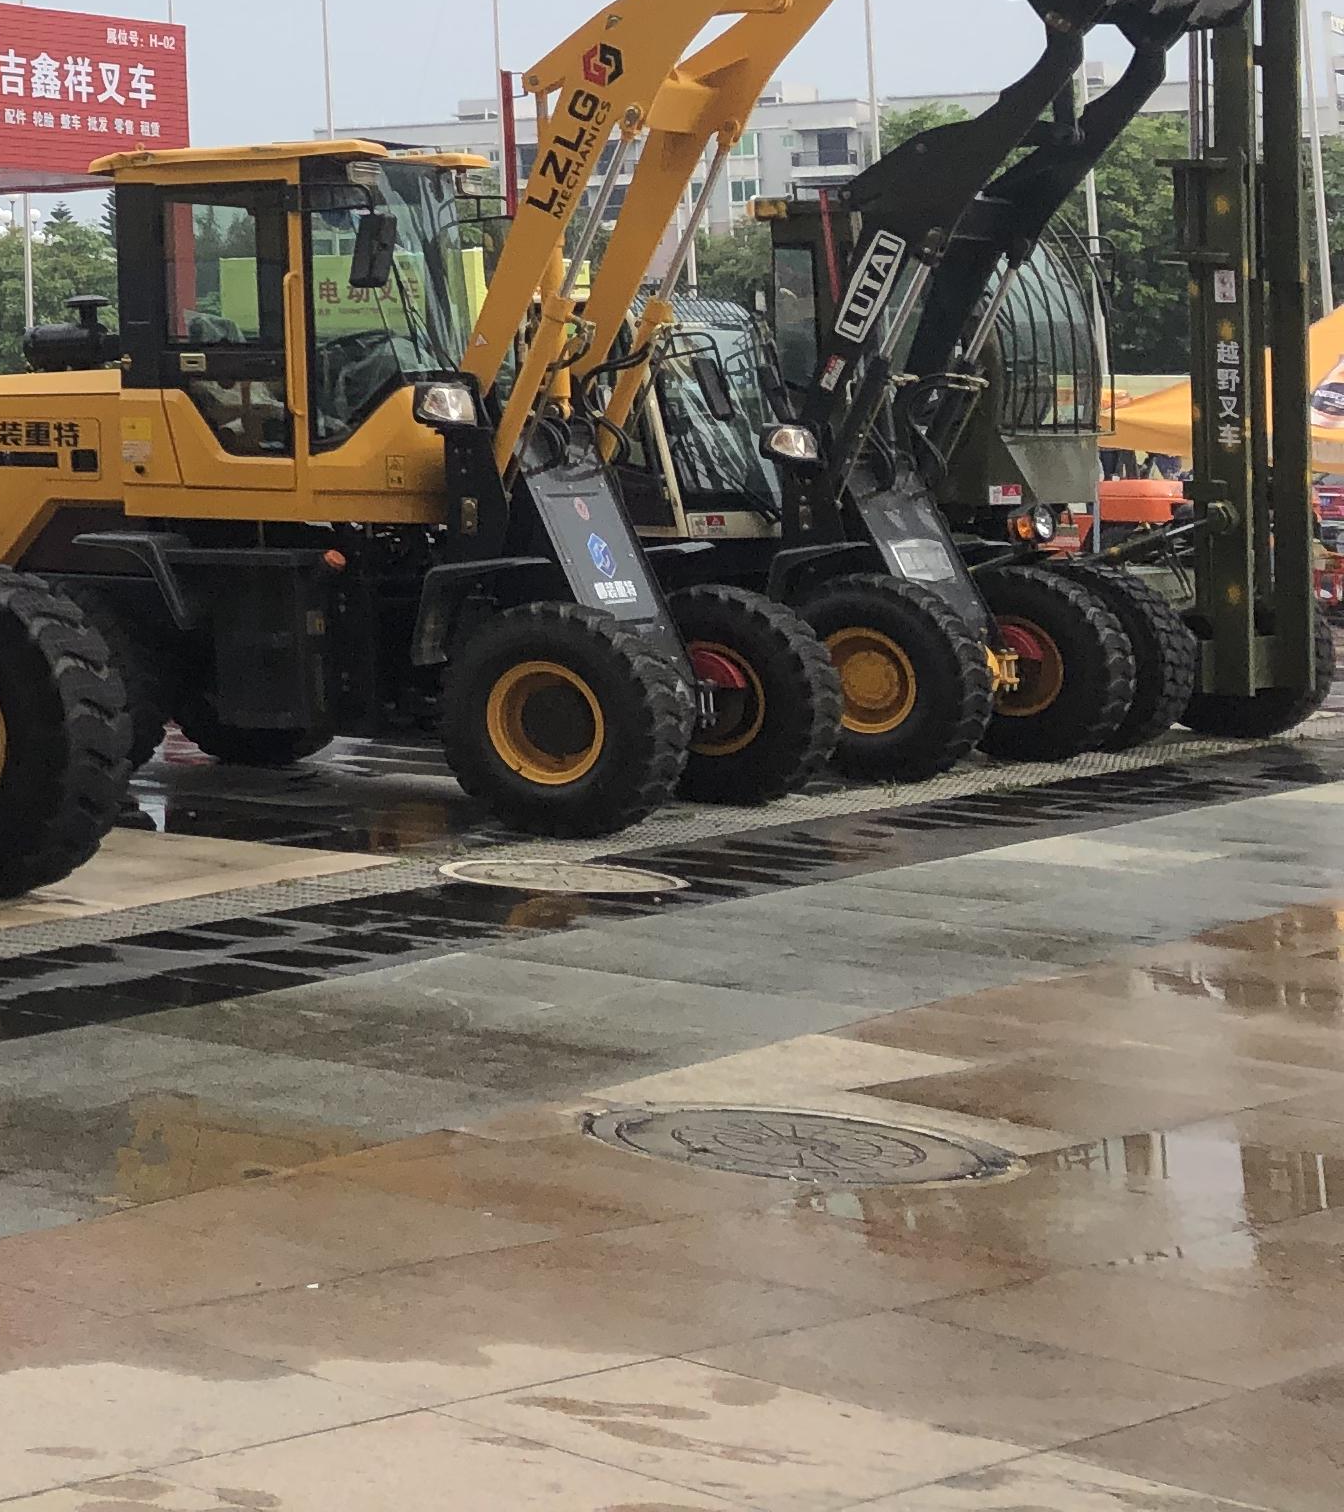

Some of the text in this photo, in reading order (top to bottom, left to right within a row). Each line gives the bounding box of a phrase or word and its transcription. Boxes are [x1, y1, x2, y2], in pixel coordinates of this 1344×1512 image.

[149, 34, 176, 50] H-02
[4, 108, 161, 137] 配件 轮胎 整车 批发 零售 租赁
[525, 89, 600, 213] LZLG
[552, 100, 612, 219] MECHANICS
[840, 237, 901, 337] LUTAI
[1216, 340, 1242, 448] 越野叉车
